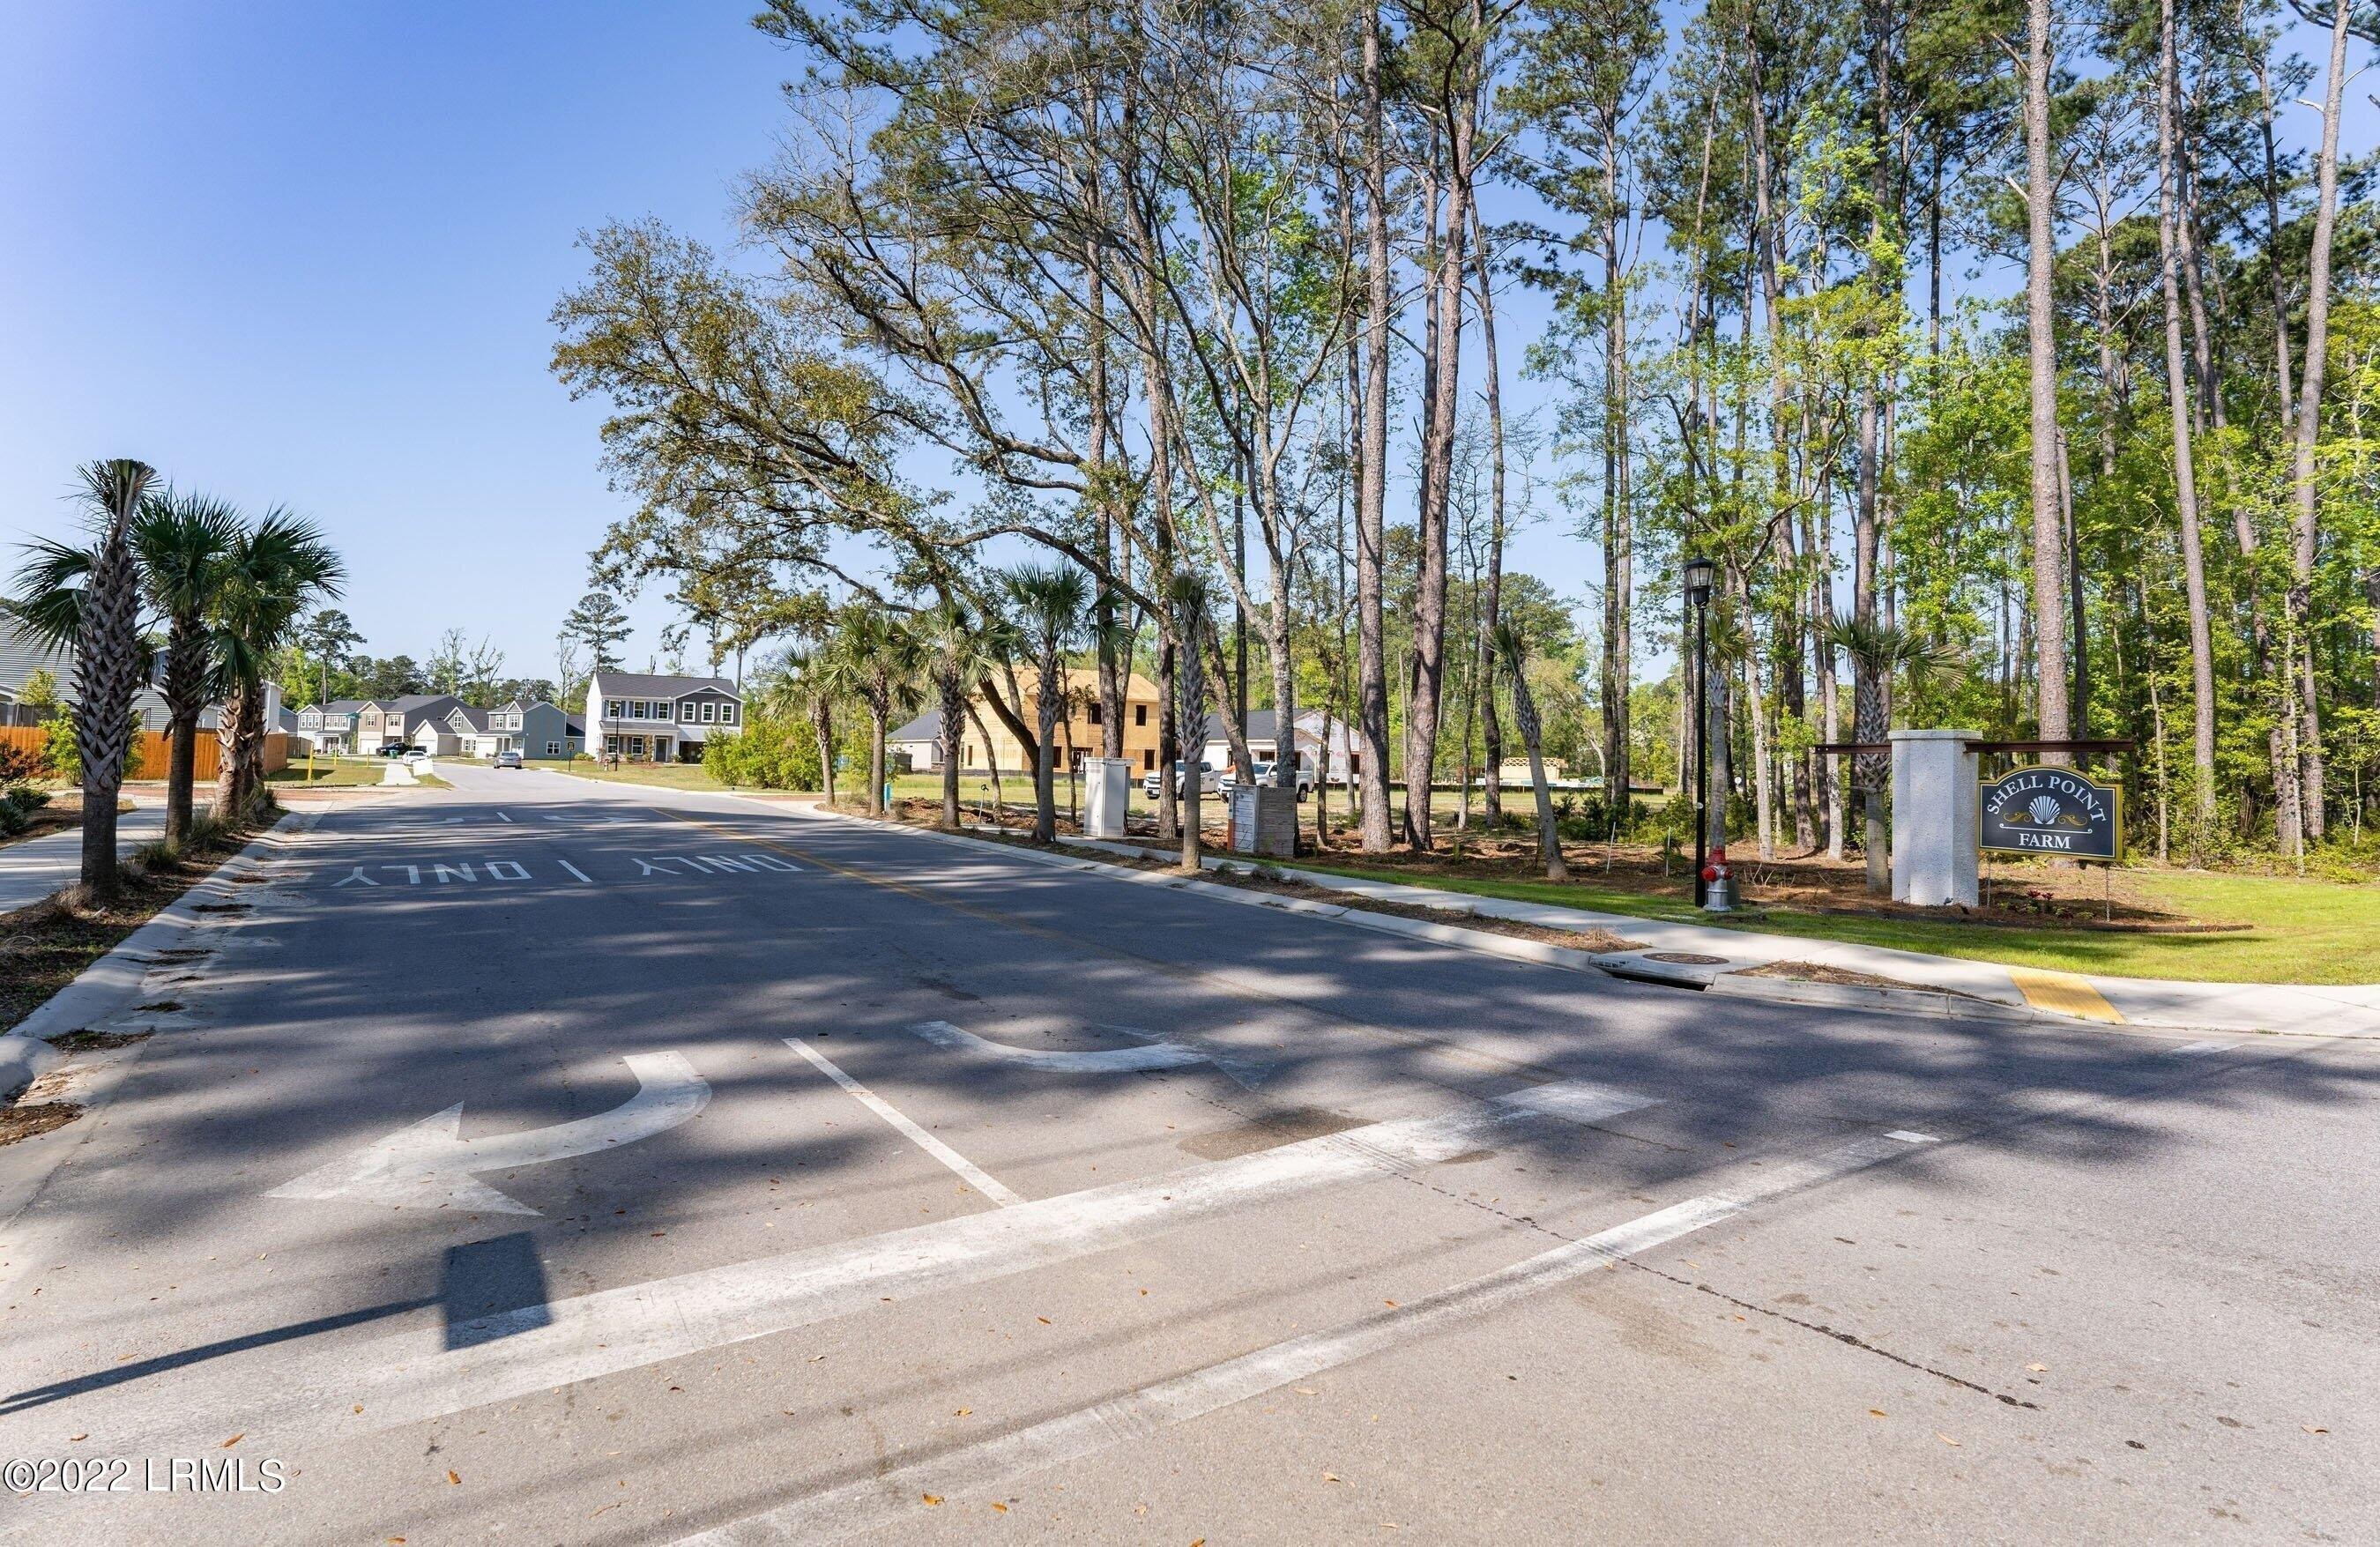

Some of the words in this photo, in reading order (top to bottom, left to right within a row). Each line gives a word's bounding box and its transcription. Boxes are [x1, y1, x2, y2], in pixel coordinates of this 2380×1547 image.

[1987, 775, 2043, 814] SHELL
[2048, 775, 2107, 822] POINT
[2019, 833, 2071, 849] FARM
[330, 860, 532, 888] ONLY
[630, 854, 805, 876] ONLY
